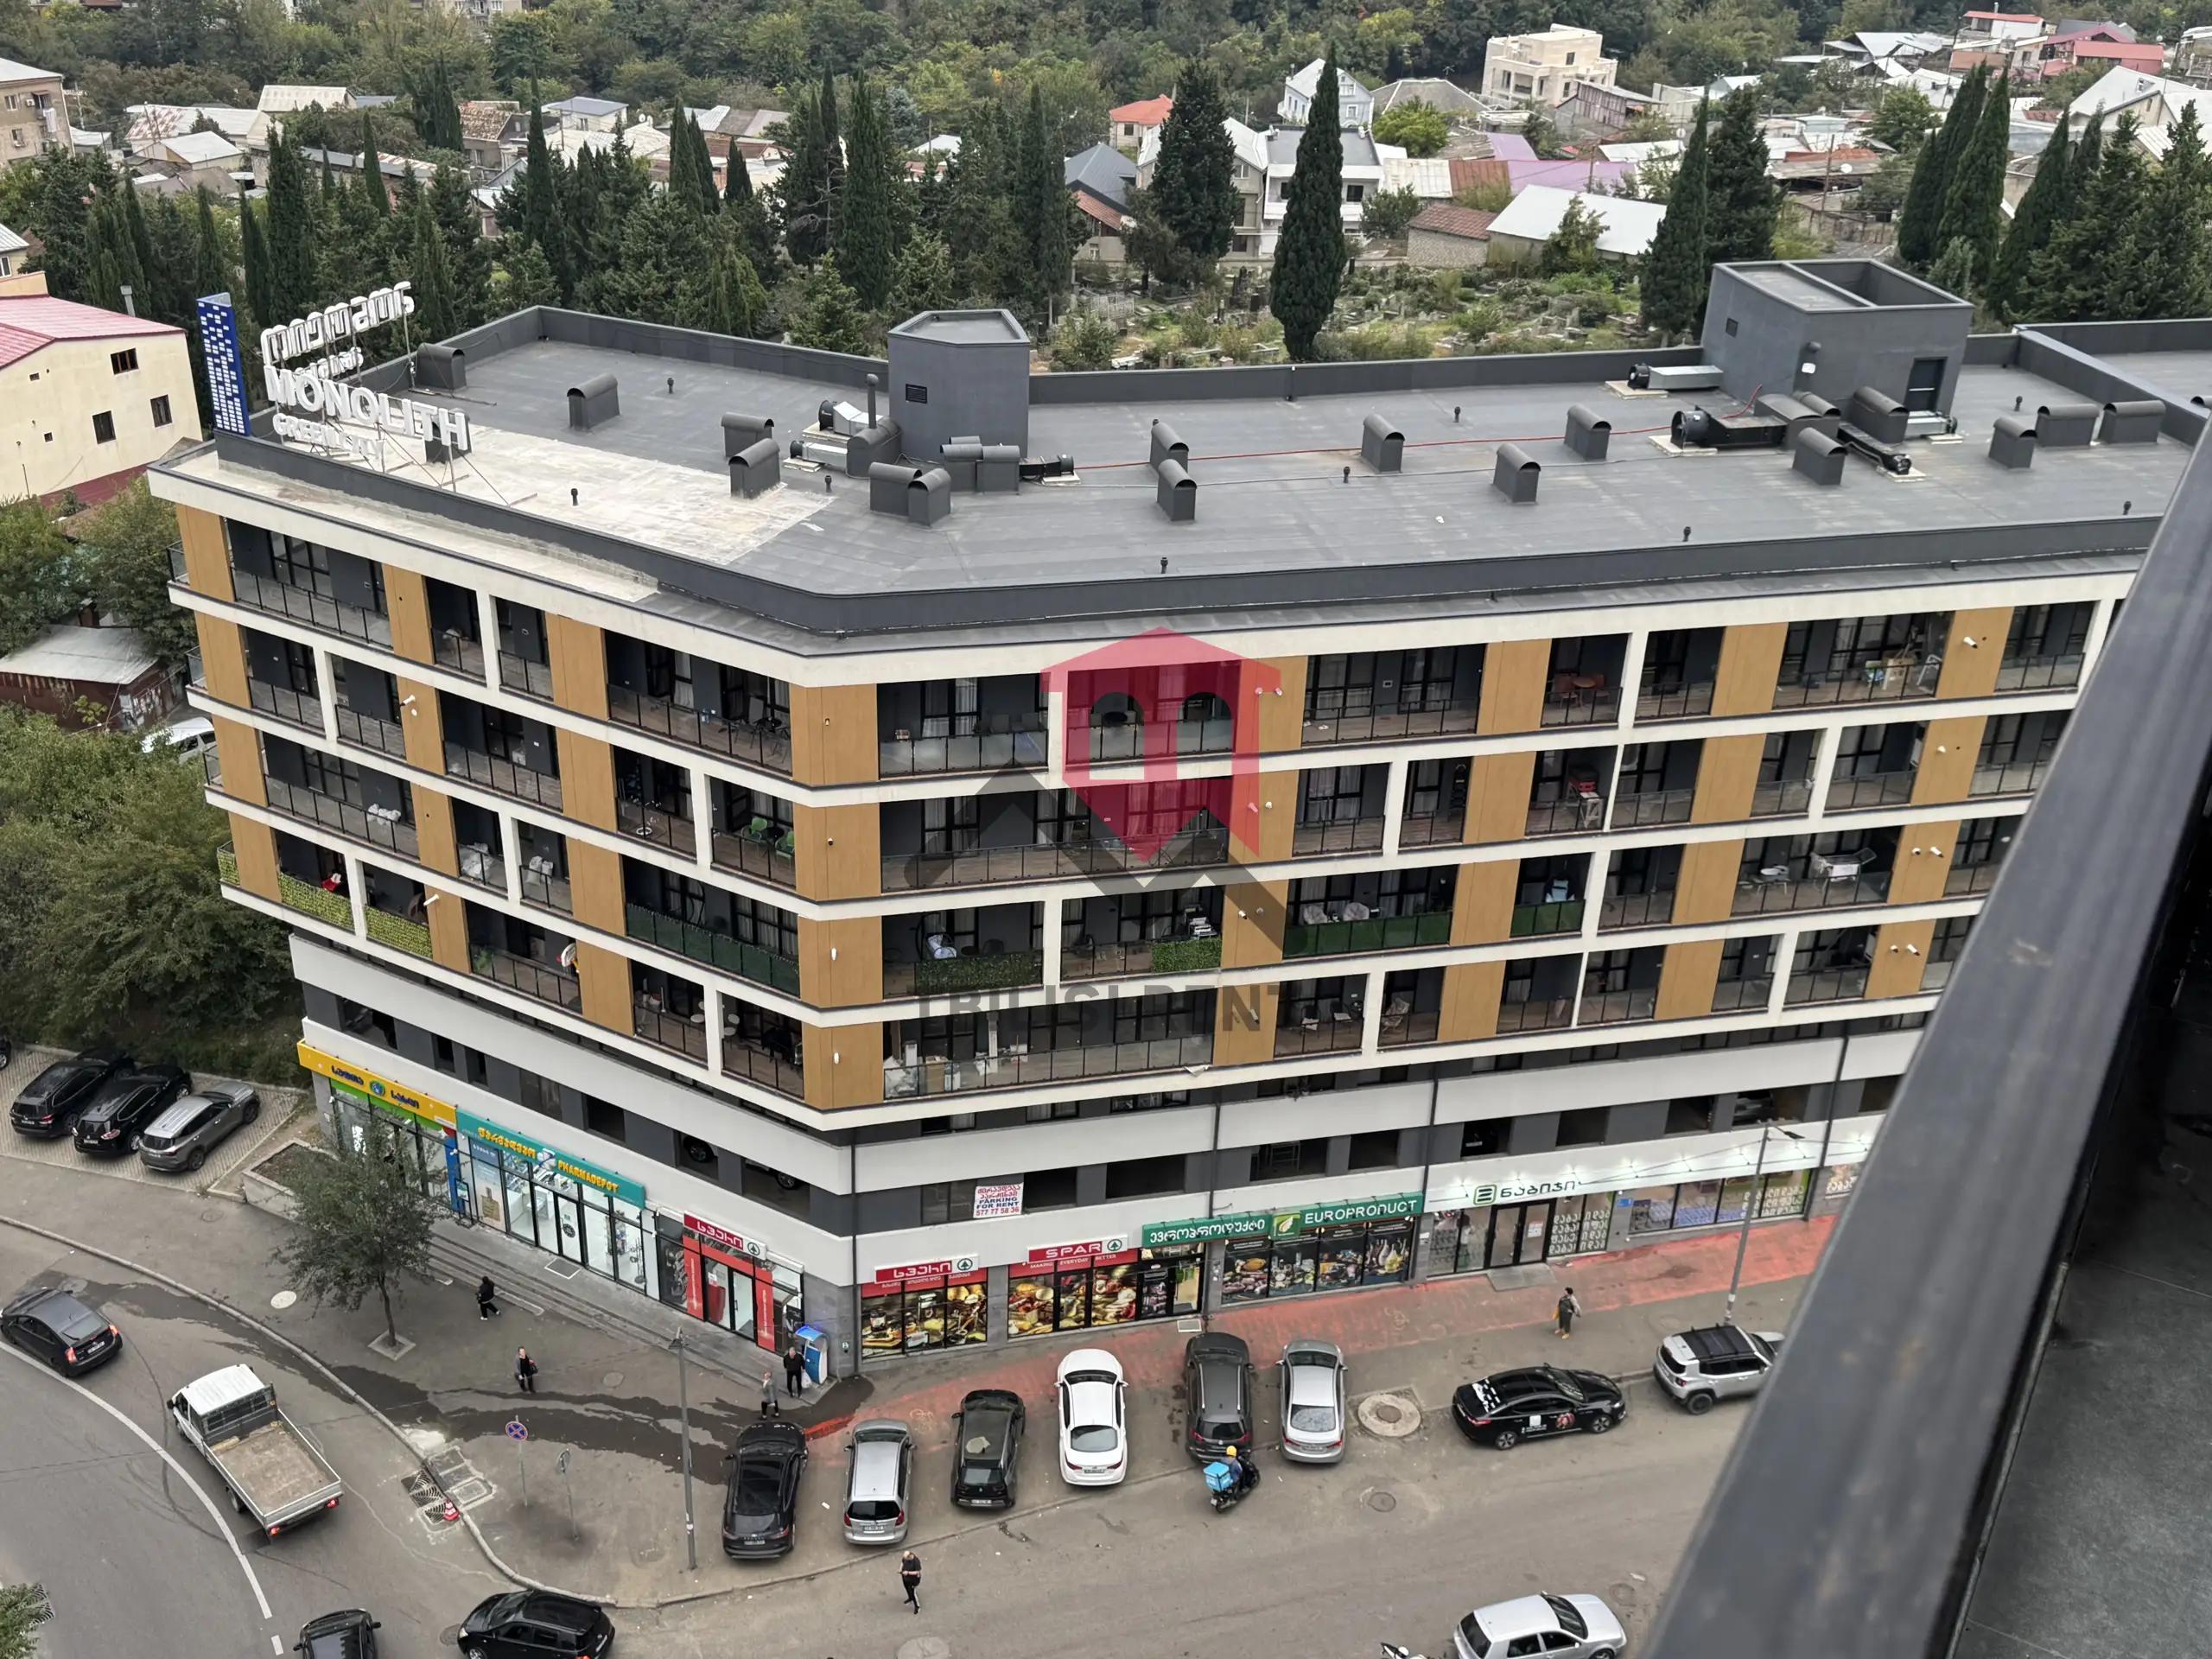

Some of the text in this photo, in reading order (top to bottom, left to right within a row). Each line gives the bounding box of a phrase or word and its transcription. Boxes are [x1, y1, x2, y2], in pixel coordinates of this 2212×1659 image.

[264, 365, 468, 450] MONOLITH
[557, 1160, 620, 1193] PHARMADEPOT
[1500, 1181, 1575, 1198] ნაბიჯი
[1305, 1200, 1418, 1224] EUROPRODUCT
[1046, 1243, 1102, 1259] SPAR
[1059, 1257, 1090, 1266] EVERYDAY
